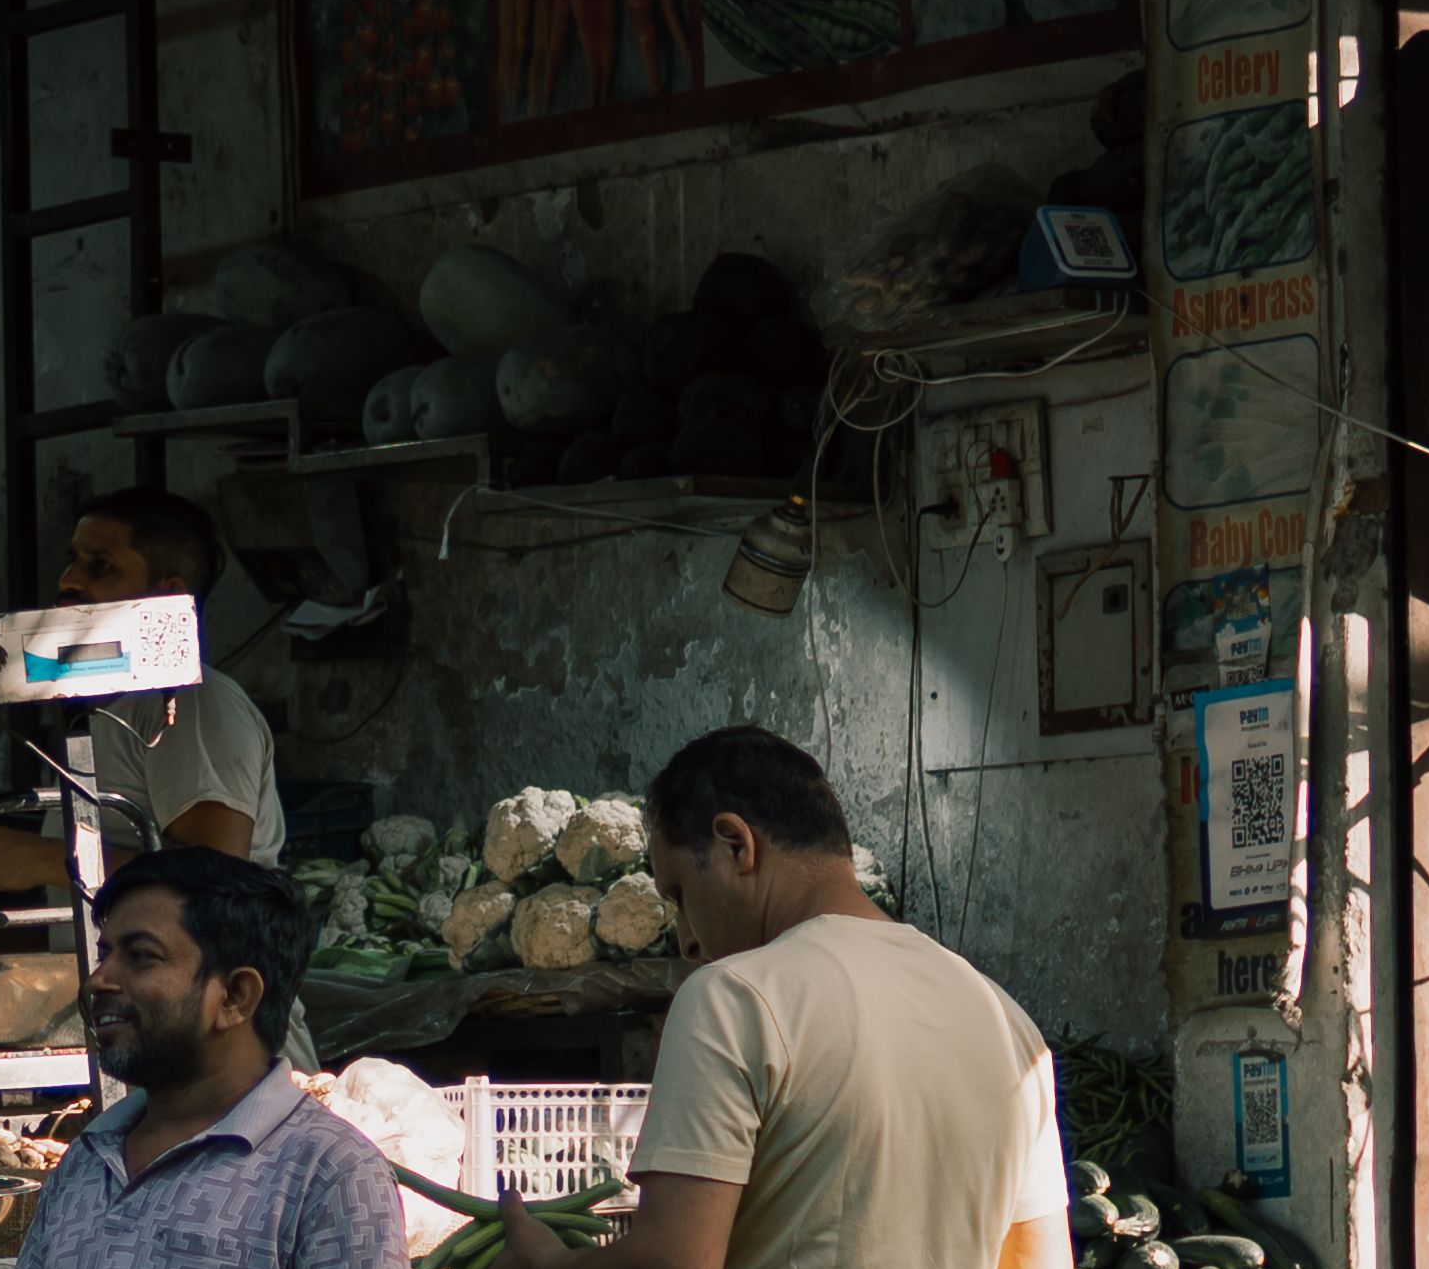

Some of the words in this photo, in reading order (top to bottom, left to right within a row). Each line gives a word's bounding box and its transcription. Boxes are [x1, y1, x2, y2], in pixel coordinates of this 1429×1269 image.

[1197, 49, 1280, 106] Celery
[1189, 513, 1253, 570] Baby
[1217, 948, 1277, 997] here
